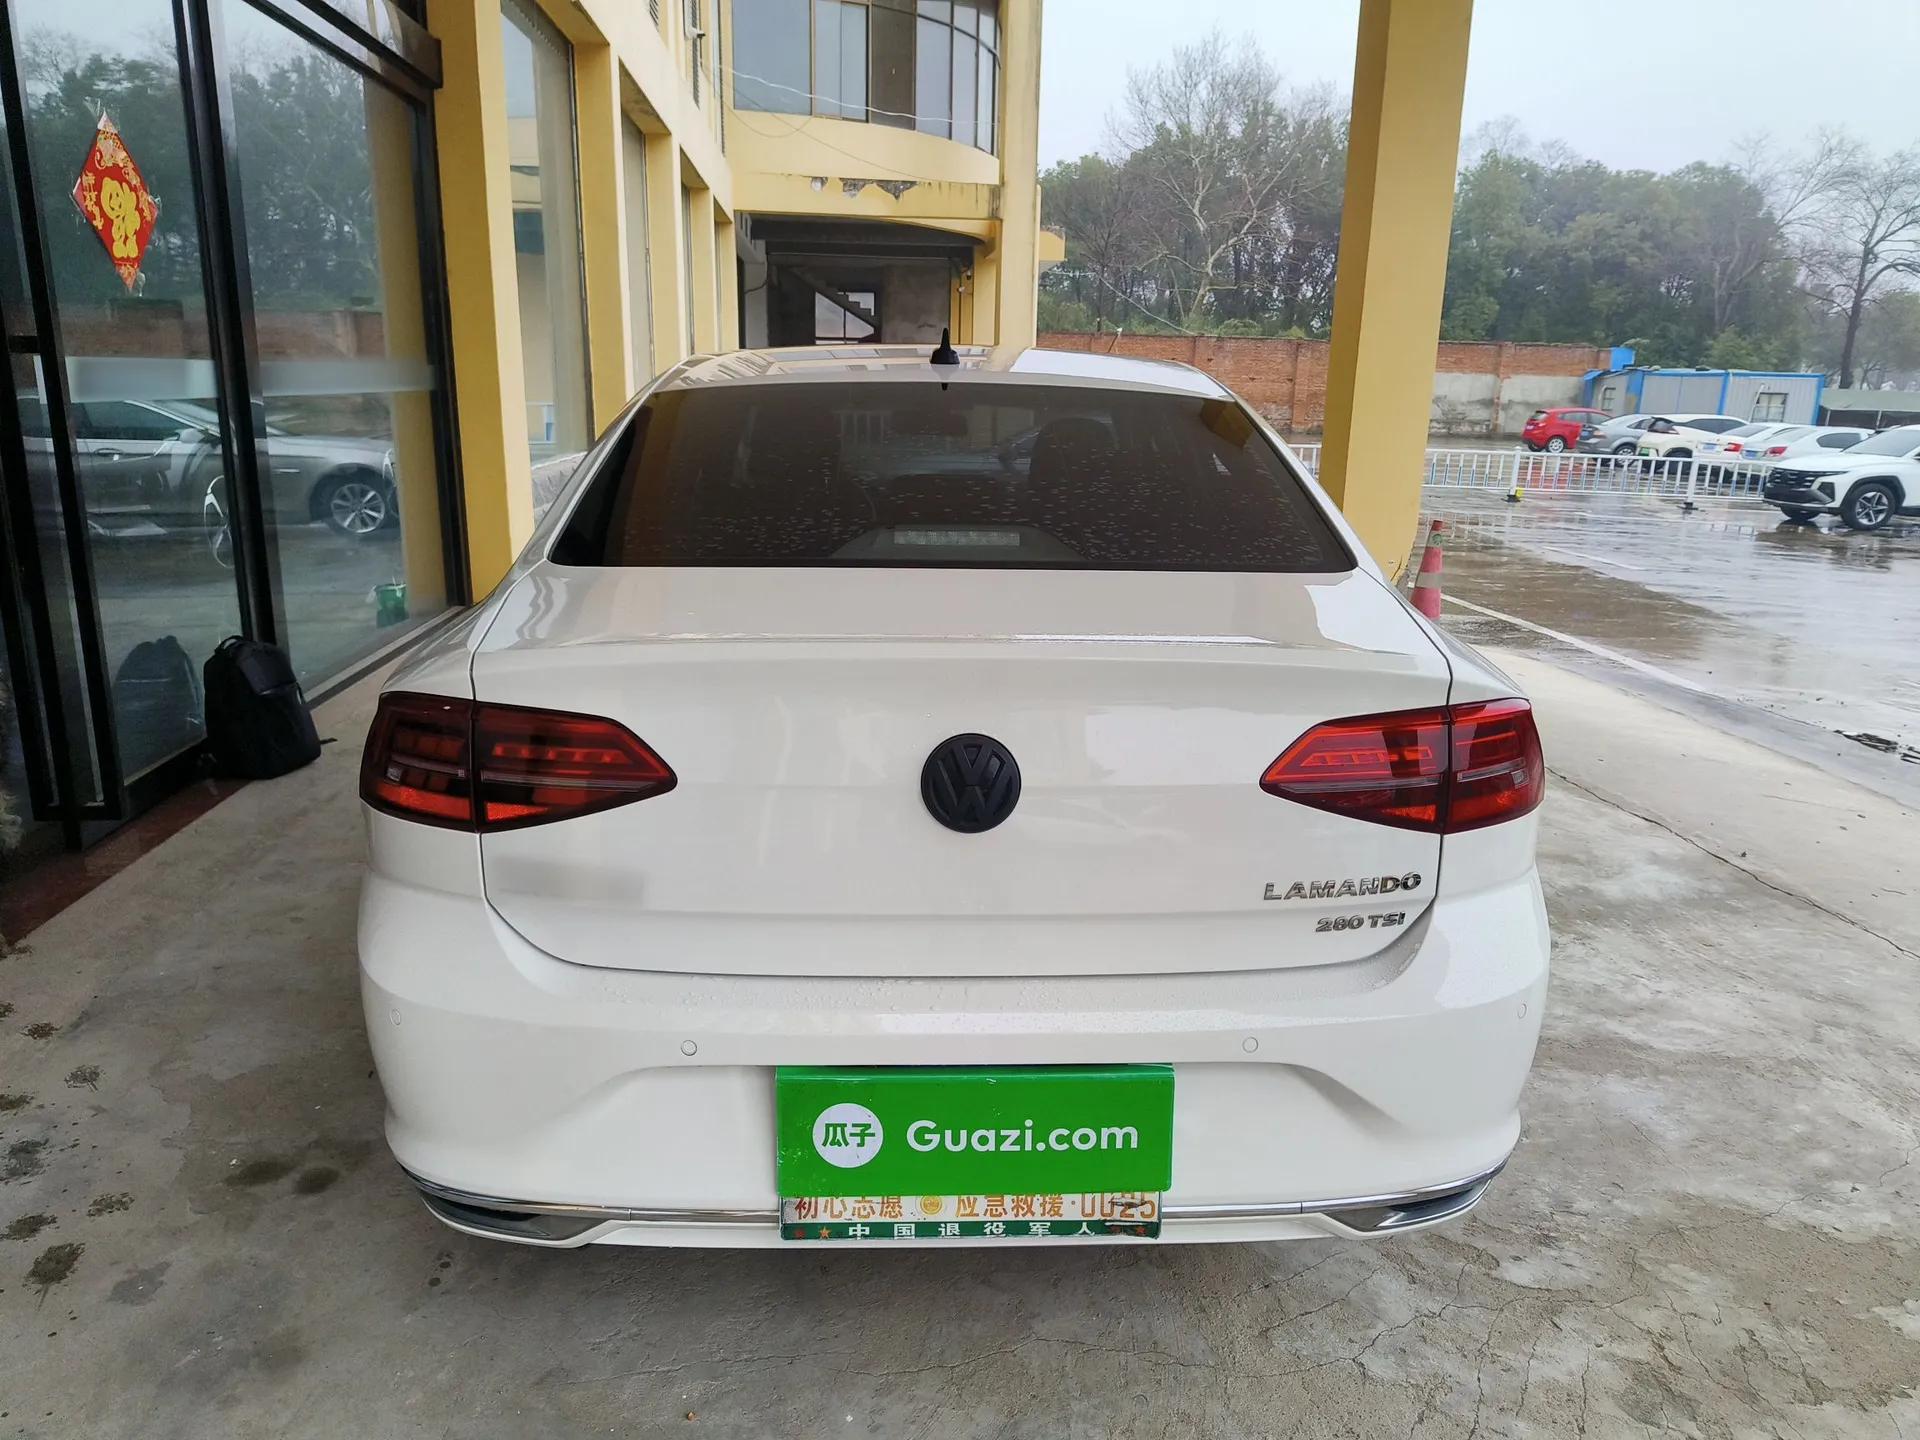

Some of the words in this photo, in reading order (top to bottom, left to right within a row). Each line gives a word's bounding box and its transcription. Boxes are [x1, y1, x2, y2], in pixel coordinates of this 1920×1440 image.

[1264, 872, 1422, 900] LAMANDO
[1316, 915, 1364, 932] 280
[1368, 912, 1405, 929] TSI
[822, 1122, 876, 1147] 瓜子
[906, 1119, 1138, 1152] Guazi.com
[848, 1222, 1096, 1240] 中国退役军人
